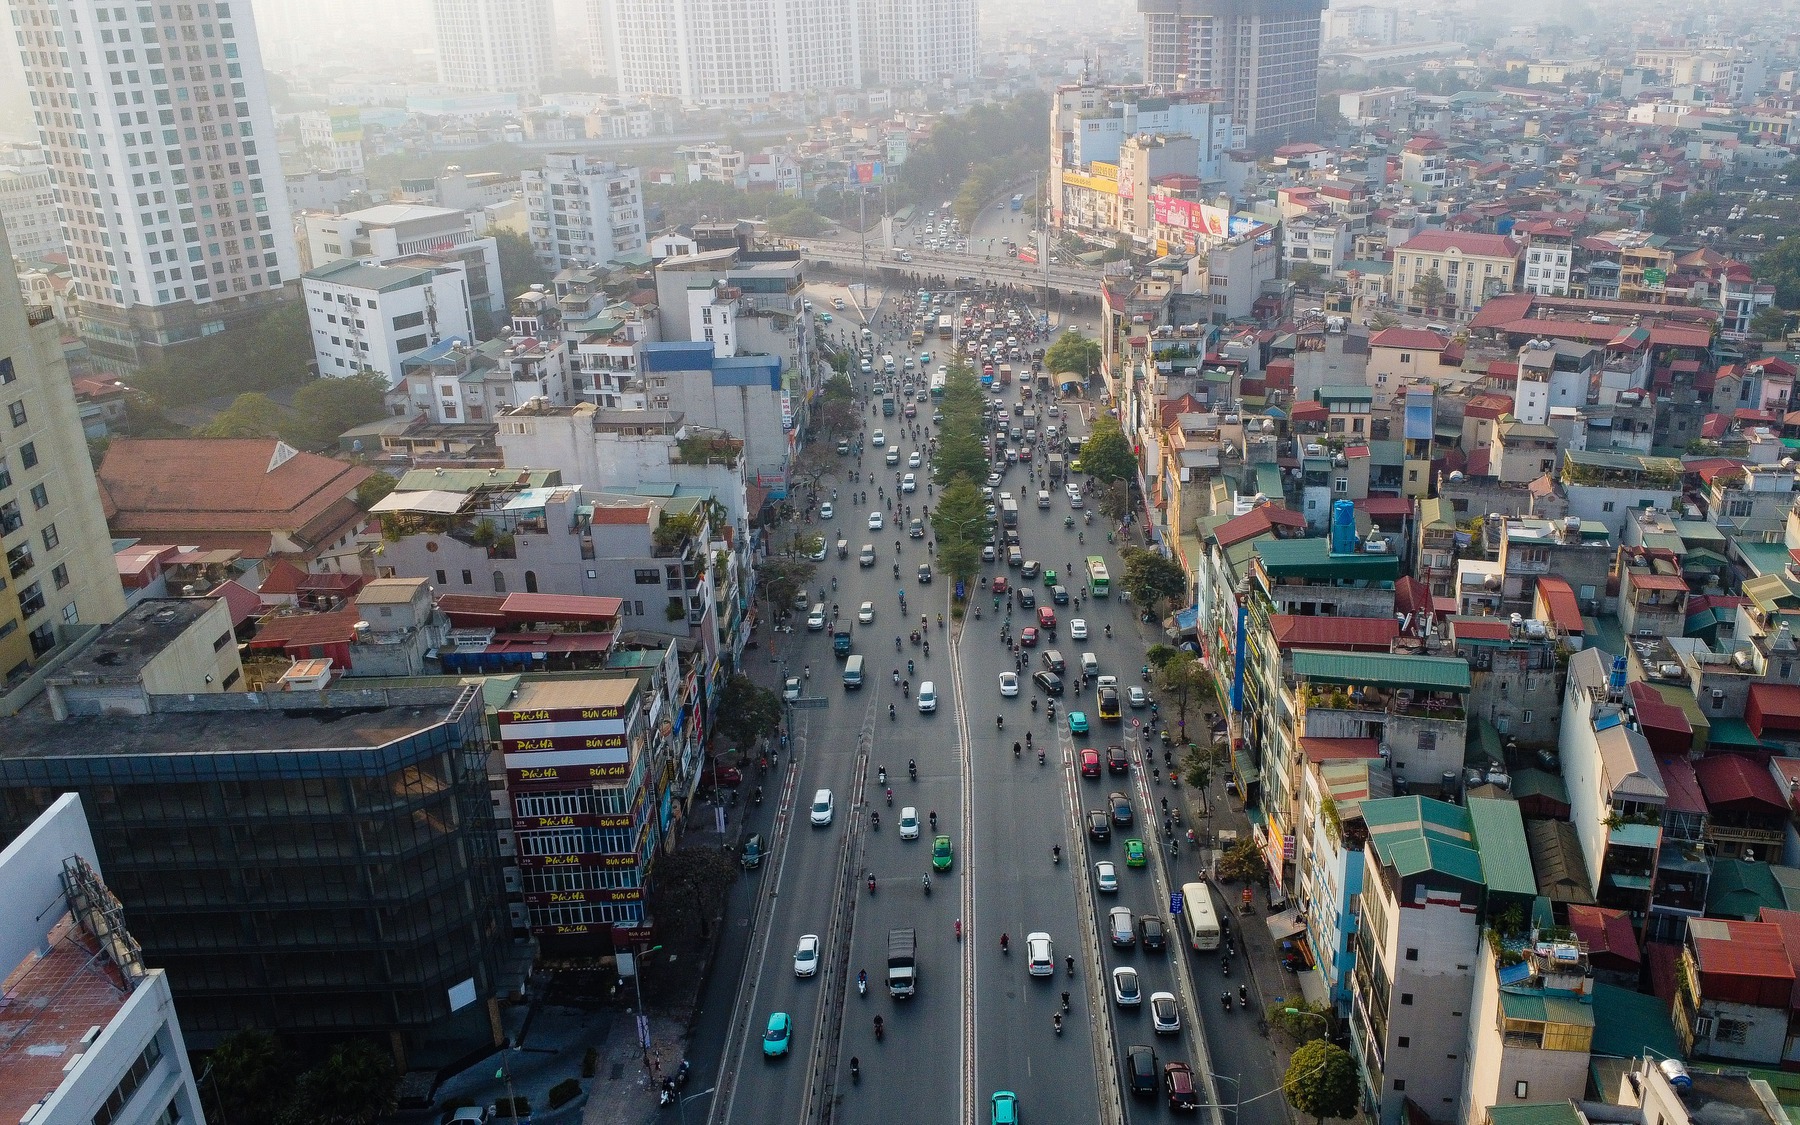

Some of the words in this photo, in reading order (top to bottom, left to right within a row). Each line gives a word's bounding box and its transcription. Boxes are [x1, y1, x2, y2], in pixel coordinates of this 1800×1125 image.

[582, 709, 599, 718] BÚN
[601, 707, 618, 717] CHẢ
[586, 737, 602, 748] BÚN
[605, 736, 621, 746] CHẢ
[590, 766, 607, 776] BÚN
[609, 764, 625, 775] CHẢ
[601, 818, 615, 826] BÚN
[616, 817, 630, 825] CHẢ
[606, 857, 619, 865] BÚN
[612, 892, 624, 900] BÚN
